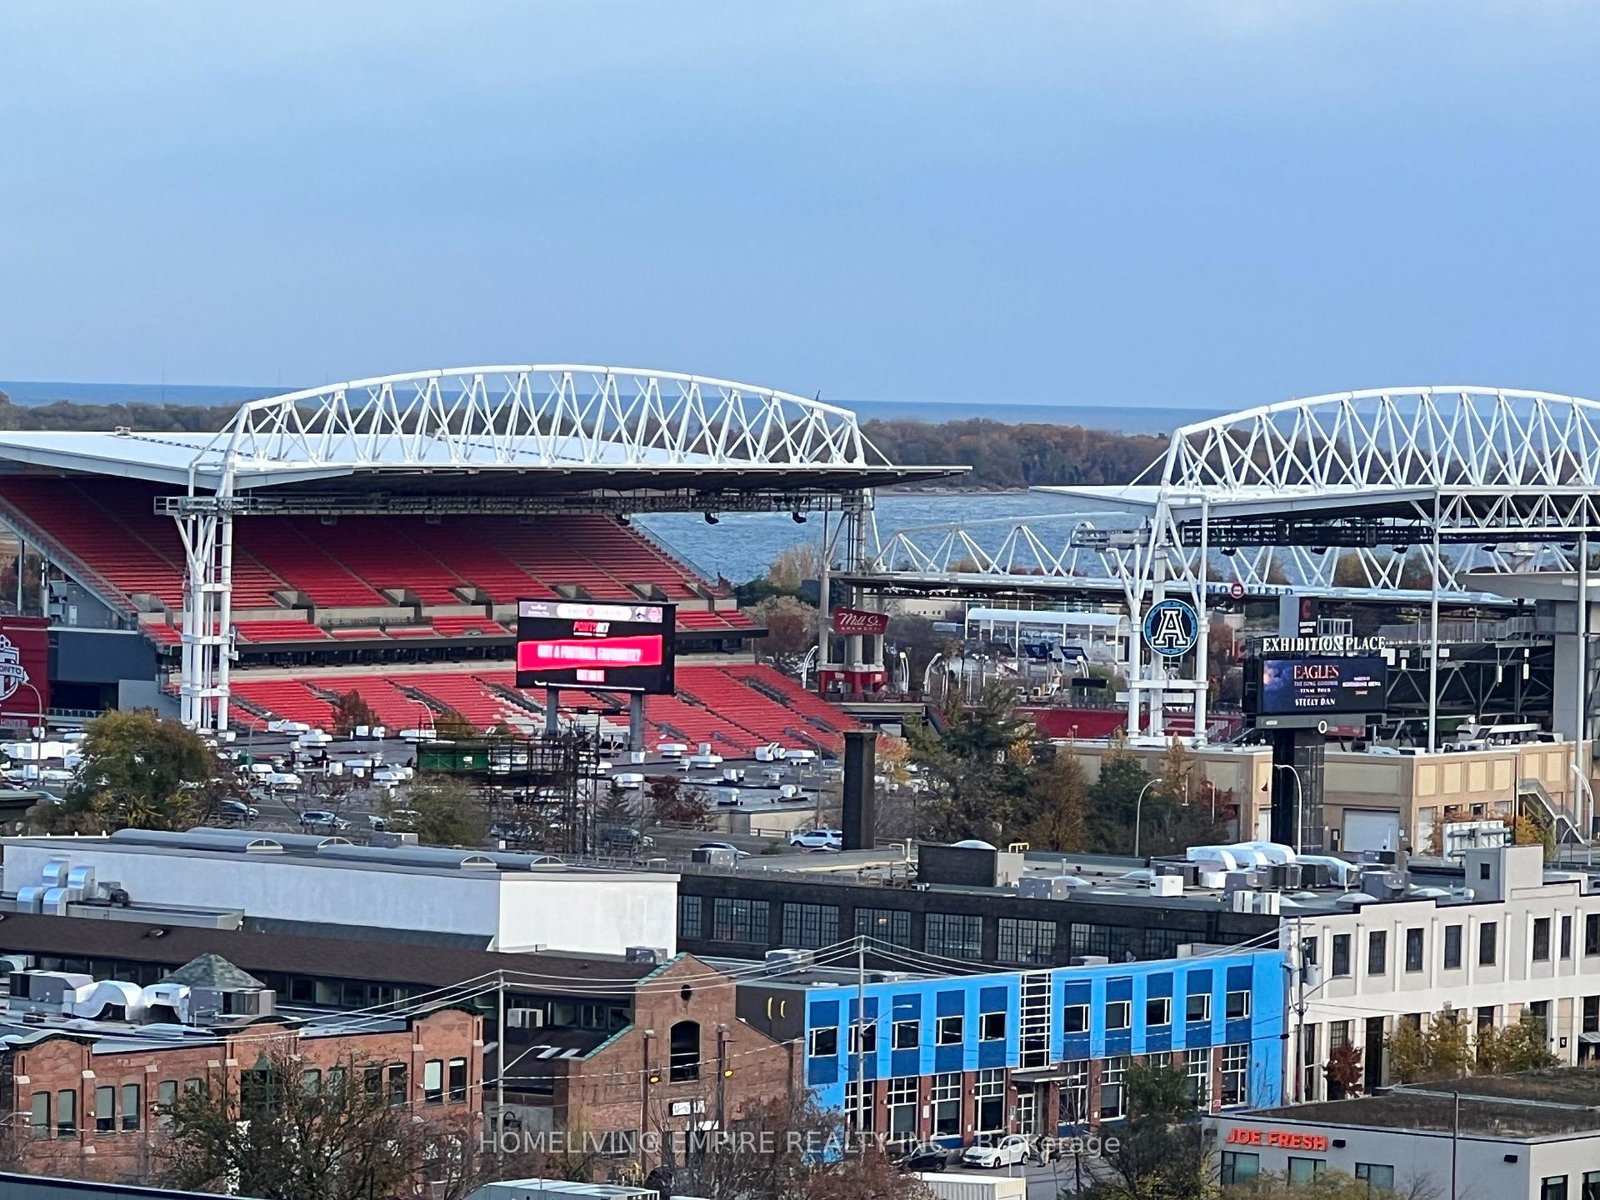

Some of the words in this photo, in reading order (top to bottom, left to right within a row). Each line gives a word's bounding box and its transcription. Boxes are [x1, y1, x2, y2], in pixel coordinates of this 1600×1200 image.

[1262, 635, 1344, 652] EXHIBITION
[1345, 636, 1386, 651] PLACE
[1294, 664, 1340, 680] EAGLES
[1225, 1127, 1262, 1147] JOE
[1267, 1131, 1329, 1152] FRESH
